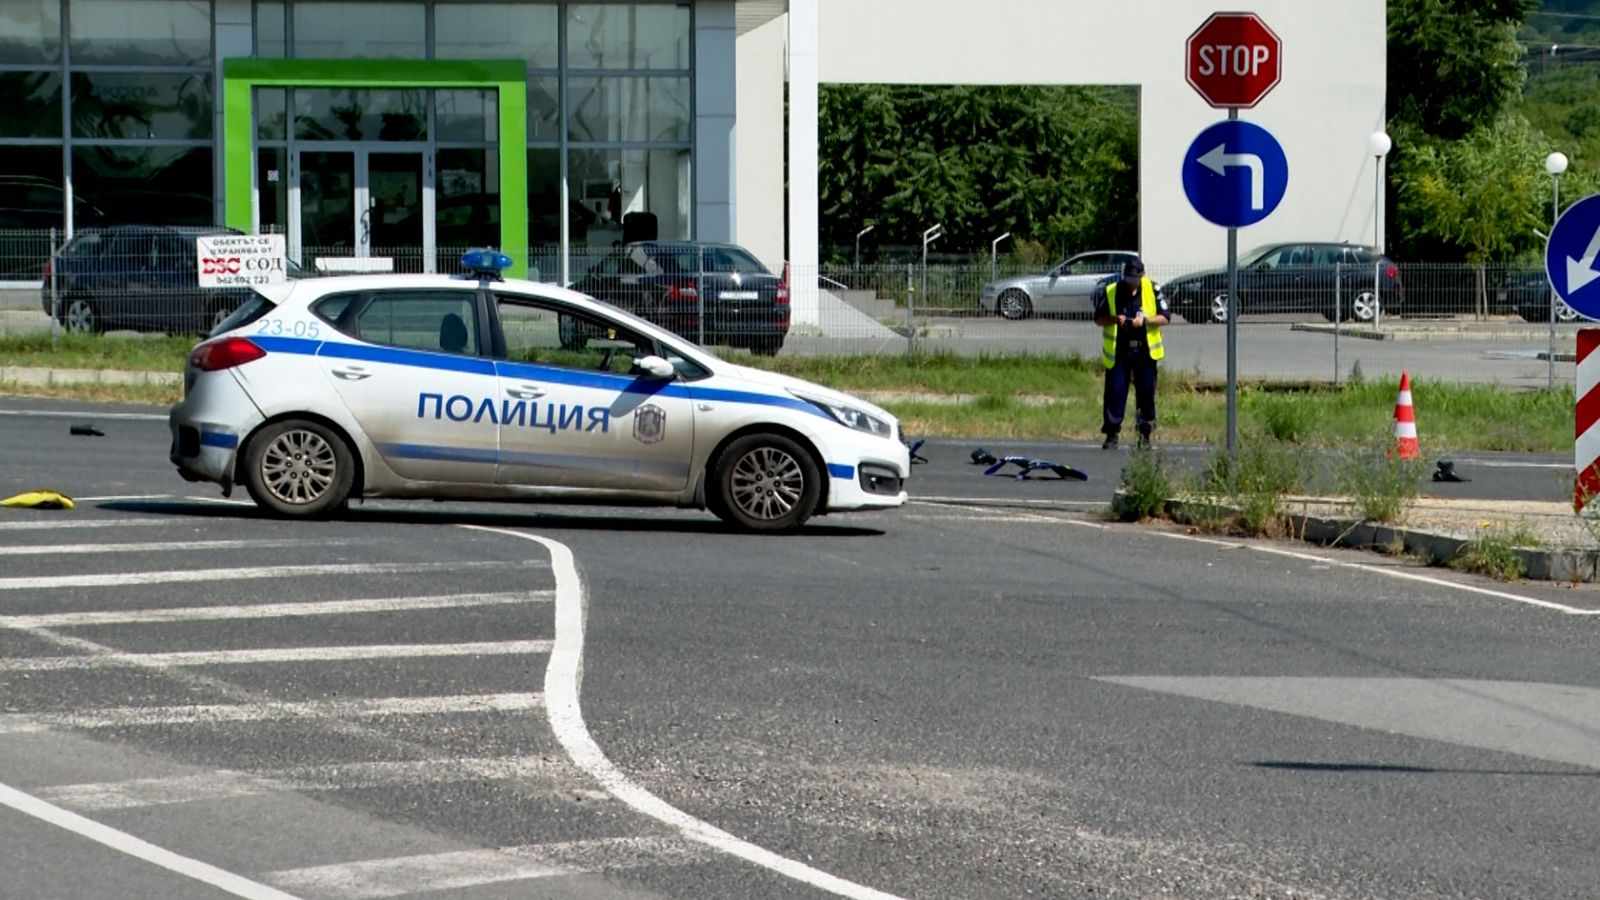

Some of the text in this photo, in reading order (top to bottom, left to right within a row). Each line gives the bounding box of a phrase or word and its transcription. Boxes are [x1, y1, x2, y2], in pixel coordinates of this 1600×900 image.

[1198, 44, 1270, 76] STOP
[246, 257, 282, 272] СОД
[257, 319, 320, 338] 23-05
[417, 392, 611, 434] ПОЛИЦИЯ
